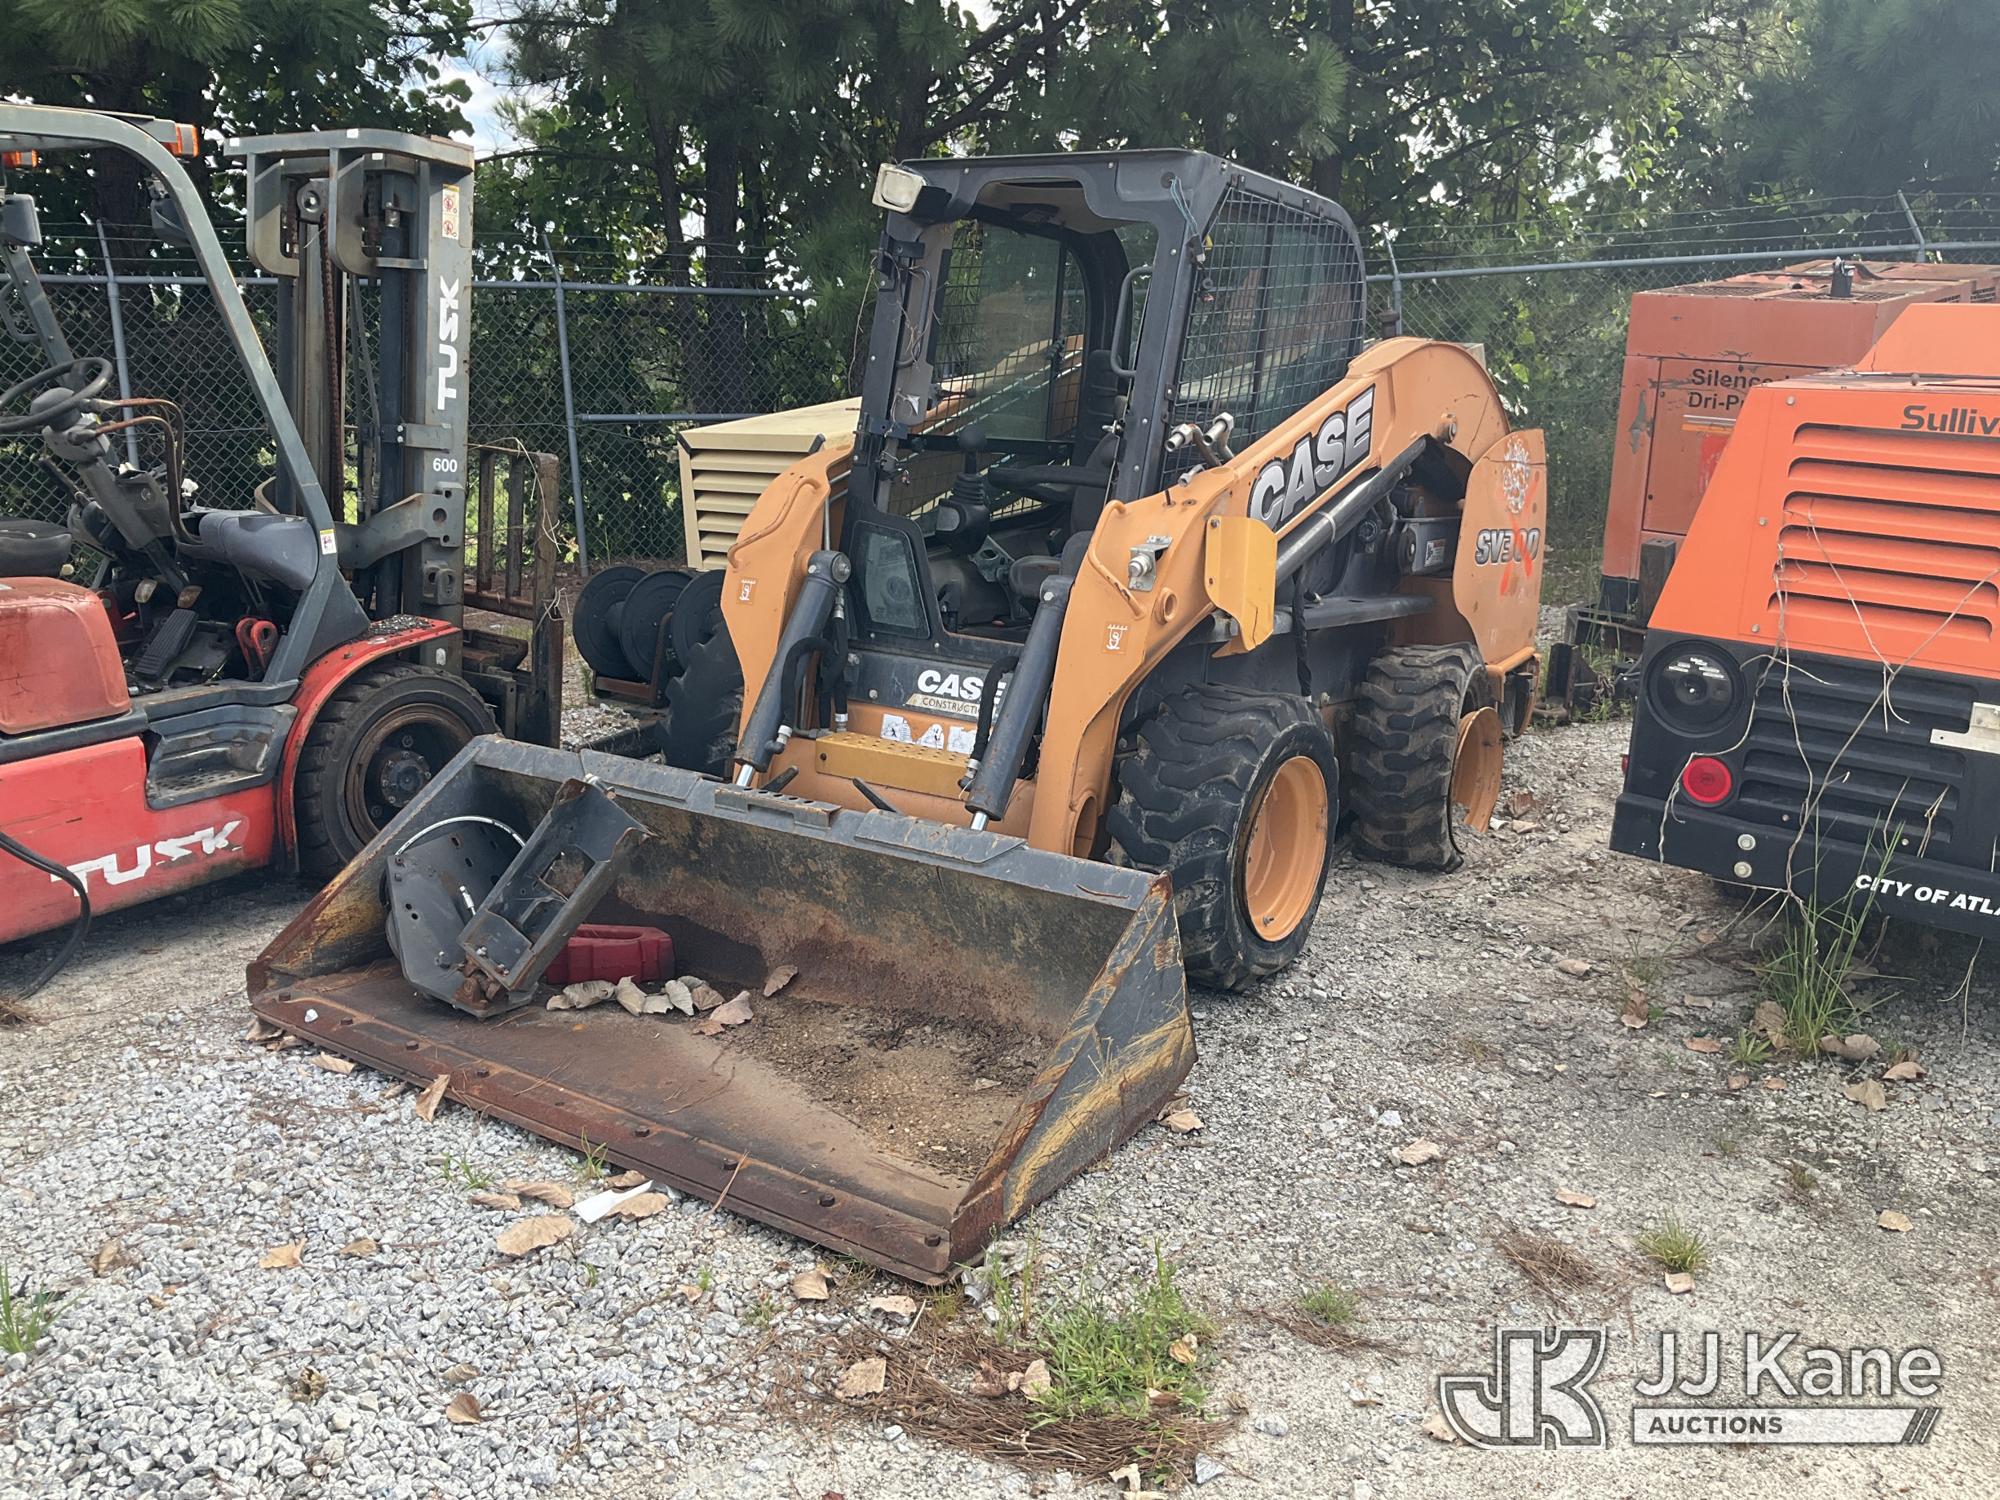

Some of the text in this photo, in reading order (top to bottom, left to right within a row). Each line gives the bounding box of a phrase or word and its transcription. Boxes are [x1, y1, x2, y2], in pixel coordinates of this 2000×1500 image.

[437, 275, 459, 411] TUSK
[1901, 405, 2000, 435] Sulliv
[432, 458, 458, 473] 600
[1249, 384, 1375, 531] CASE
[51, 820, 242, 897] TUSK
[1855, 874, 1912, 897] CITY
[1914, 886, 1949, 904] OF
